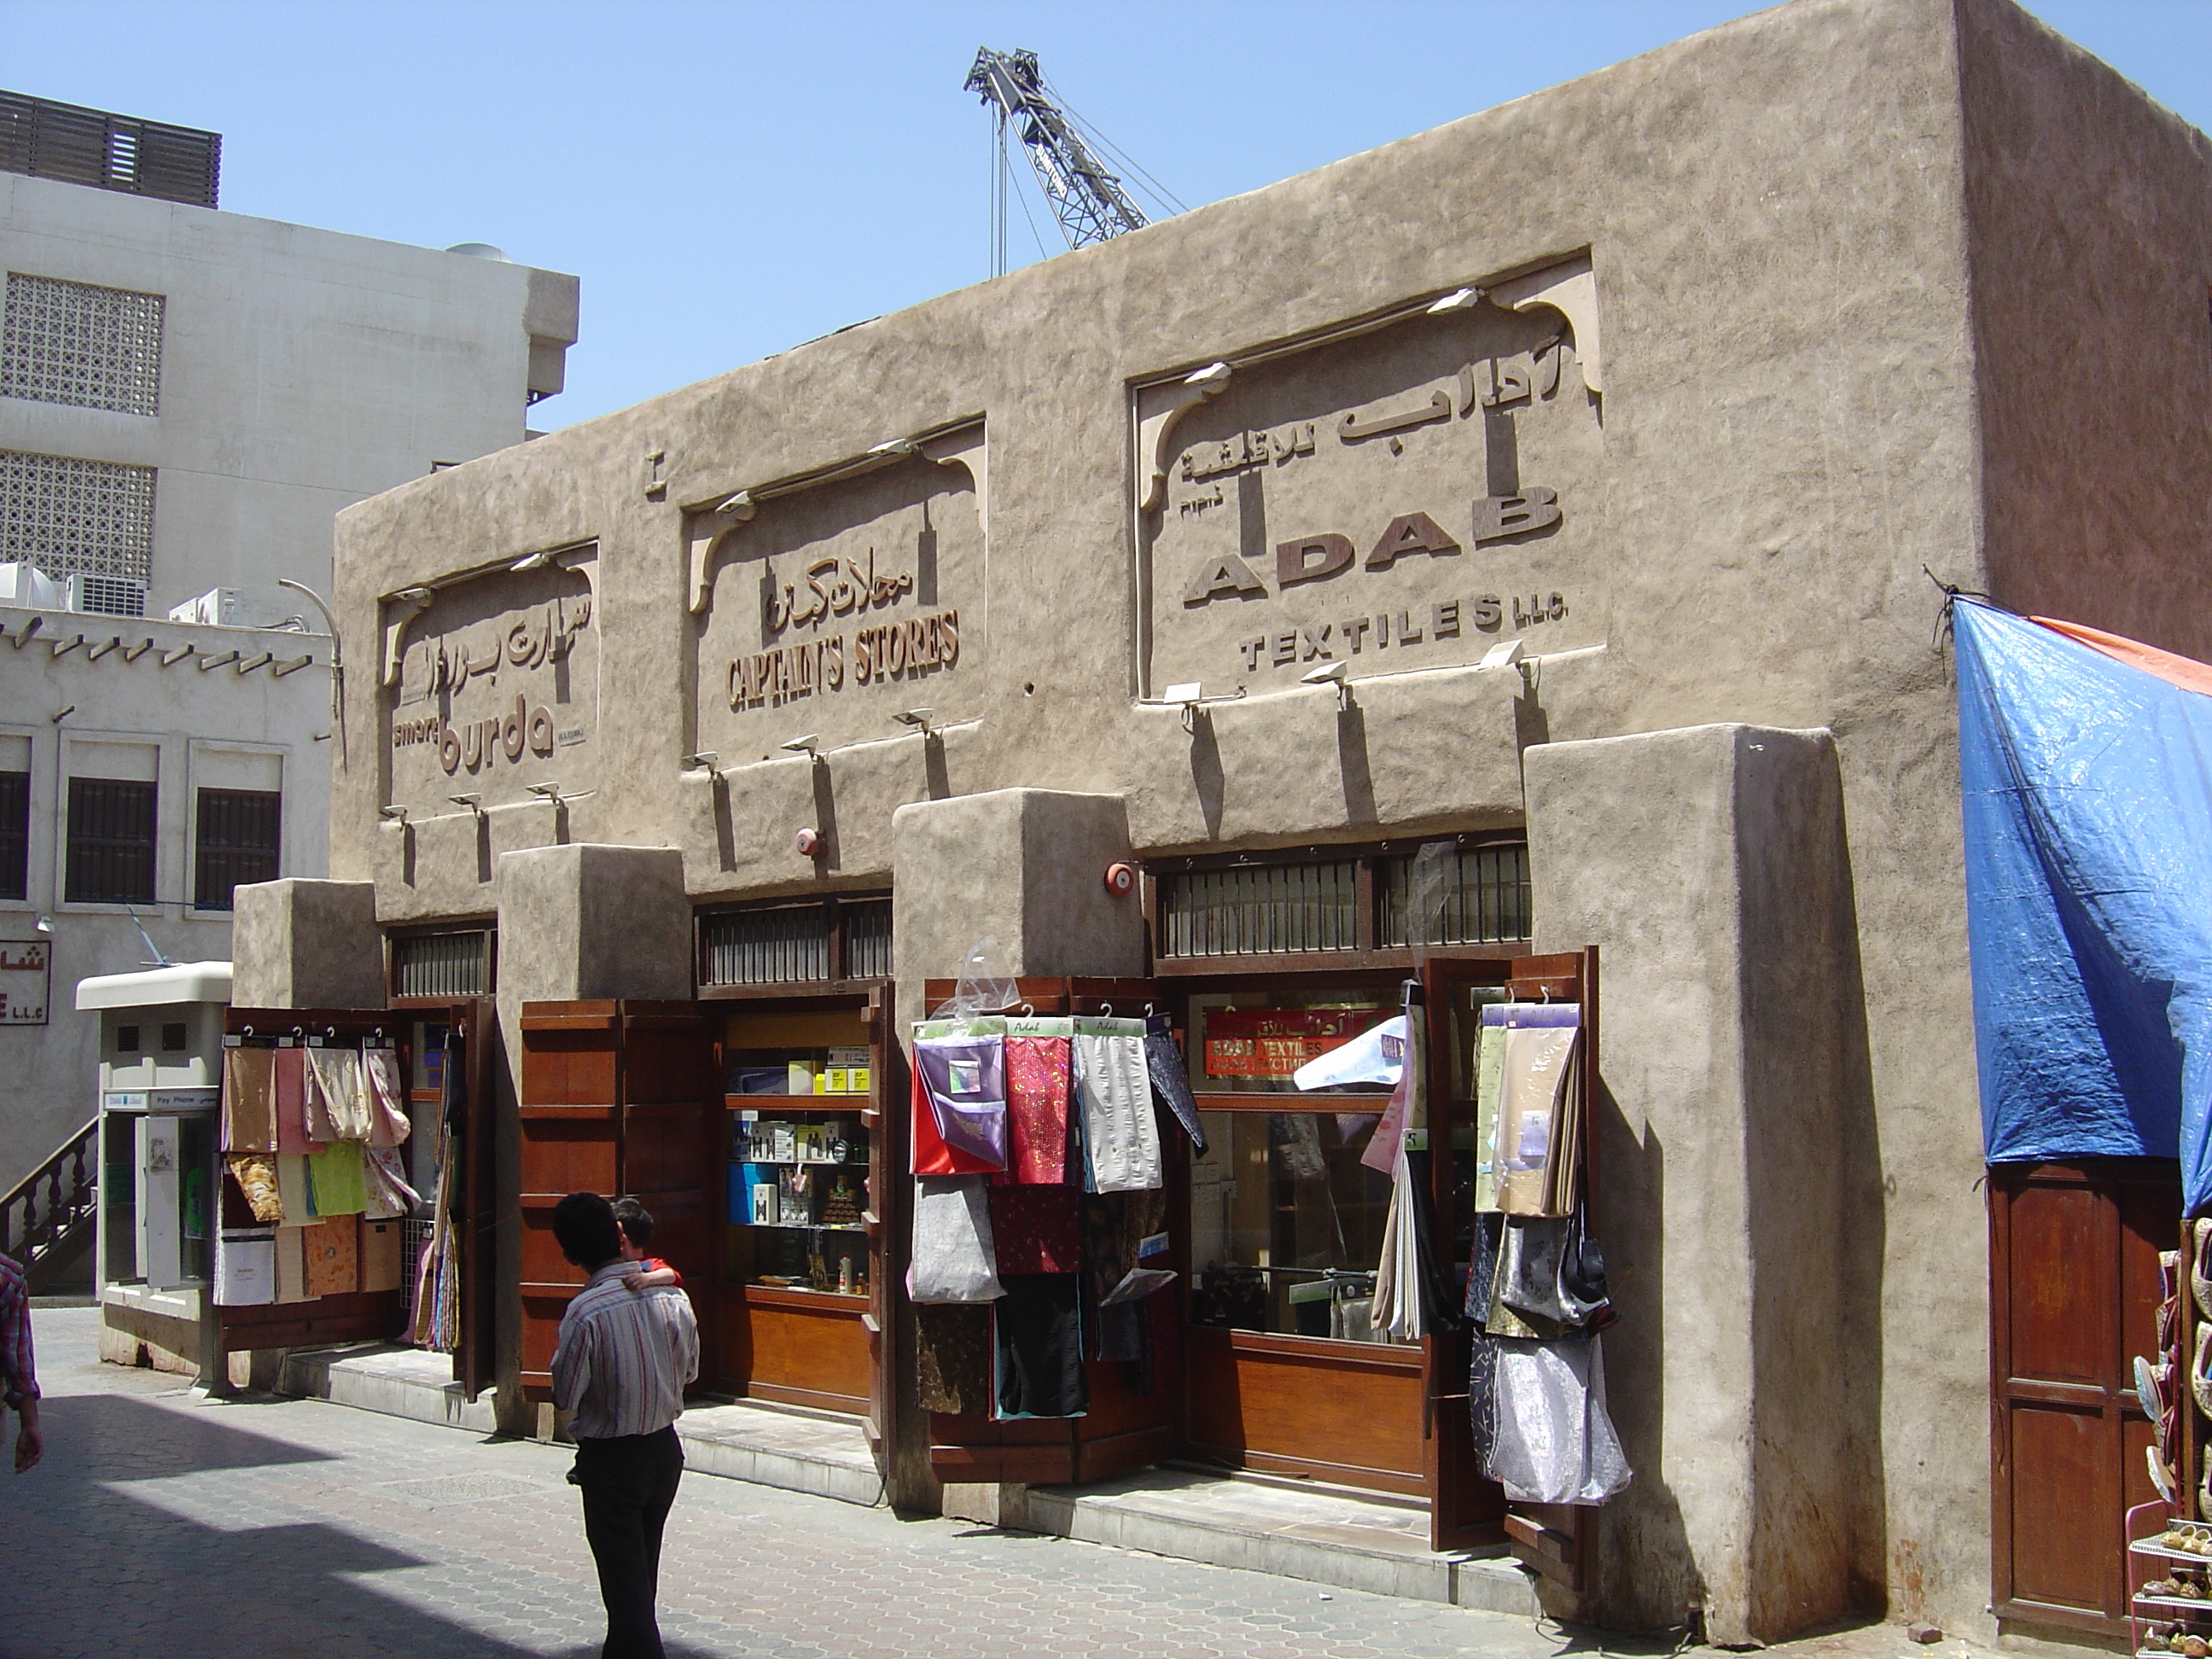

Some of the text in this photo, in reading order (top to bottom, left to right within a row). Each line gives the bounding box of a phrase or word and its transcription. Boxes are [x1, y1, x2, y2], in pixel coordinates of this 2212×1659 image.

[1035, 143, 1068, 198] SUMITOMO
[1184, 486, 1563, 608] ADAB
[726, 609, 960, 707] CAPTAIN'S STORES
[1239, 593, 1503, 670] TEXTILES
[393, 718, 438, 748] smart
[439, 693, 554, 774] burda
[1210, 1039, 1323, 1057] ADAB TEXTILES
[157, 1097, 170, 1105] Pay
